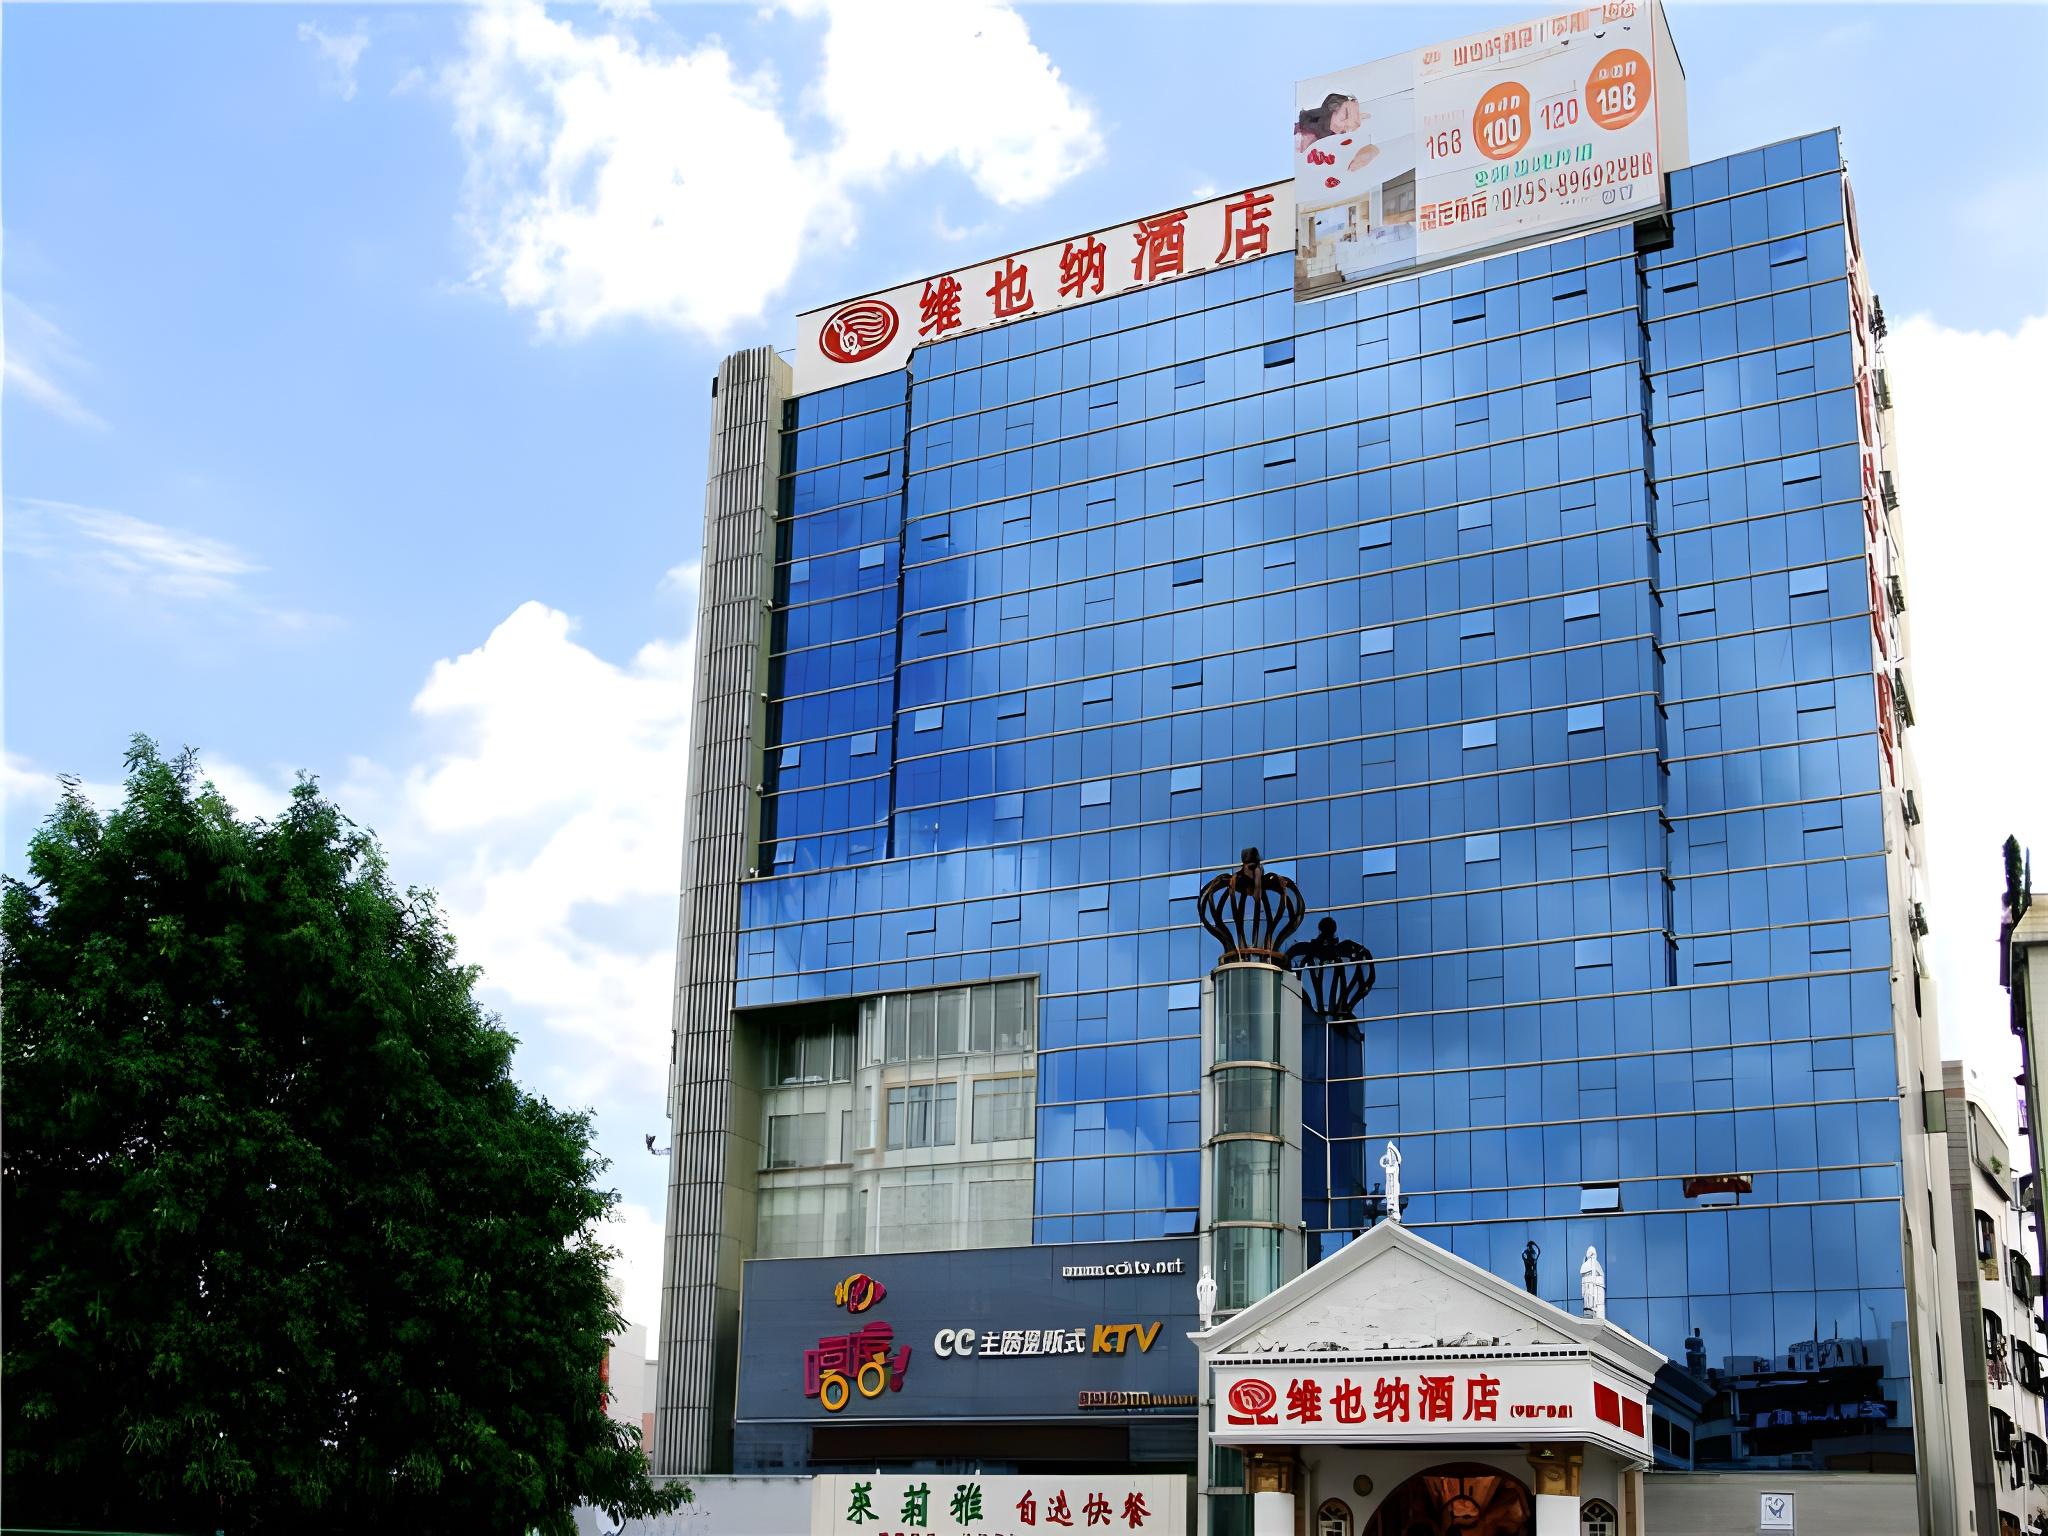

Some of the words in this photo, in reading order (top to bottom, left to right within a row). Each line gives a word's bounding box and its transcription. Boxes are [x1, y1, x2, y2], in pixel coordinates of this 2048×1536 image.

[1483, 114, 1522, 148] 100
[917, 191, 1275, 337] 维也纳酒店
[934, 1328, 975, 1357] CC
[1092, 1321, 1162, 1353] KTV
[1286, 1373, 1501, 1424] 维也纳酒店
[1016, 1488, 1152, 1529] 自选快餐
